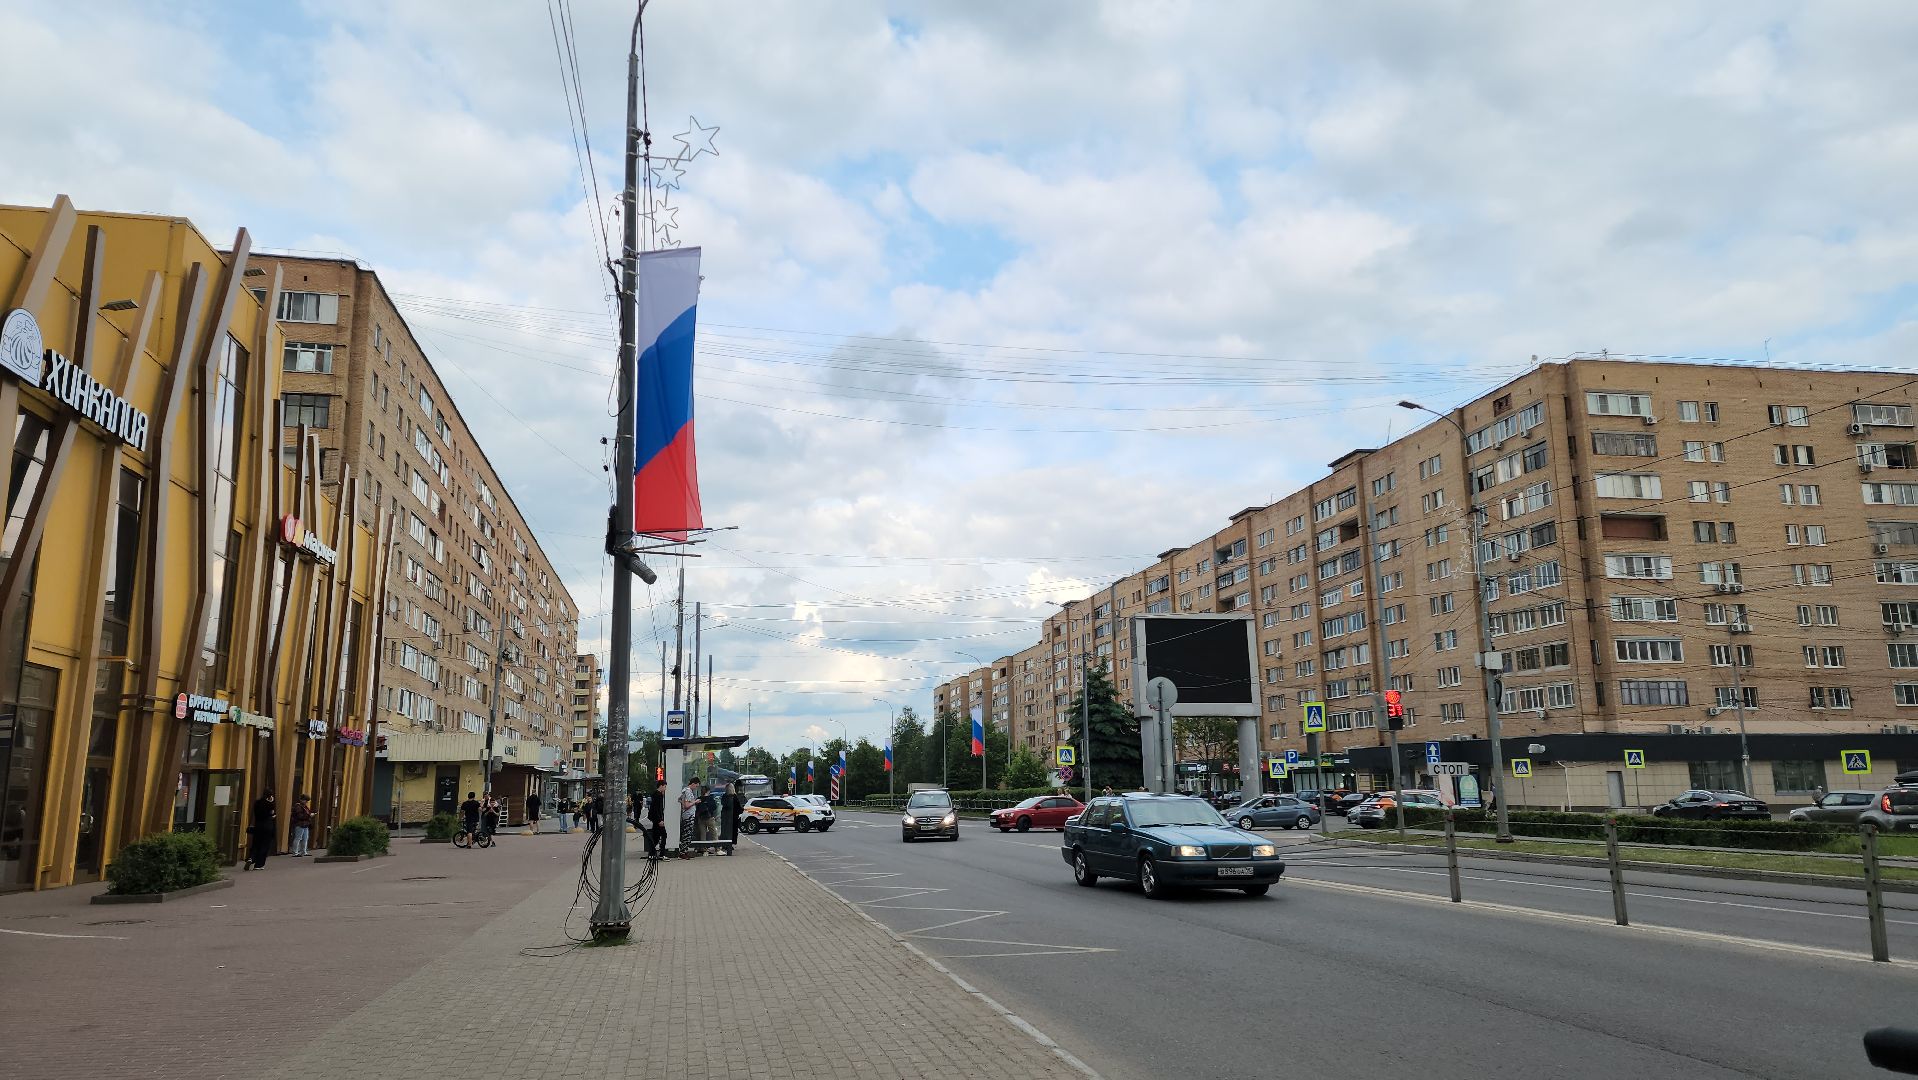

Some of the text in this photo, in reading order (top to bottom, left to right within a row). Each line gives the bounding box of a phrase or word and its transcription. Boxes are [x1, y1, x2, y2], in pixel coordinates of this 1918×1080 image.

[46, 349, 148, 452] ХИНКАЛИЯ
[303, 530, 337, 565] Маркет
[1287, 751, 1296, 763] P
[1433, 764, 1464, 775] СТОП
